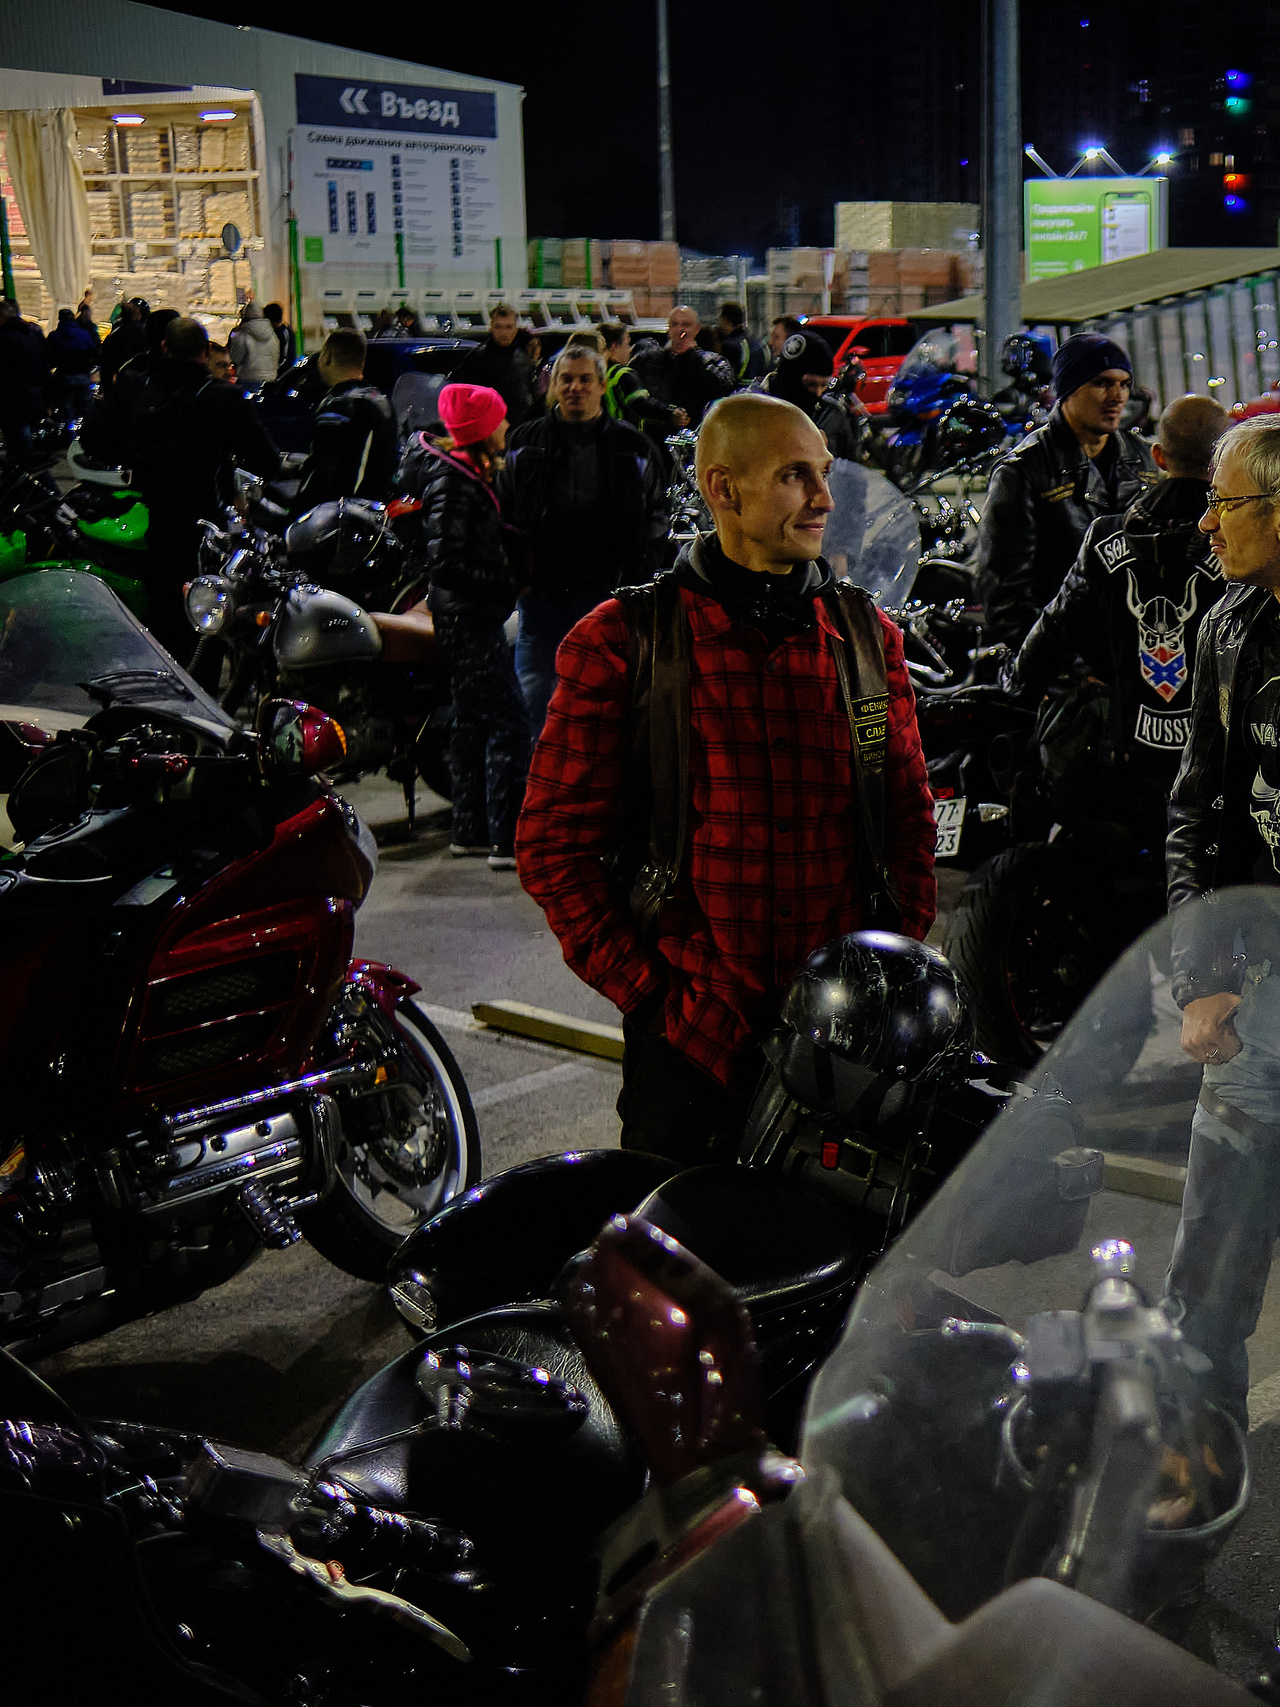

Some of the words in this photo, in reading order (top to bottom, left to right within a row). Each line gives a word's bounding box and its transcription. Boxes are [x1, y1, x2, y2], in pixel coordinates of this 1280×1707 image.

[380, 91, 460, 128] Въезд
[308, 131, 344, 144] Схема
[345, 135, 401, 148] движения
[1104, 536, 1131, 566] SOL
[1141, 712, 1191, 744] RUSSI
[937, 802, 957, 822] 77
